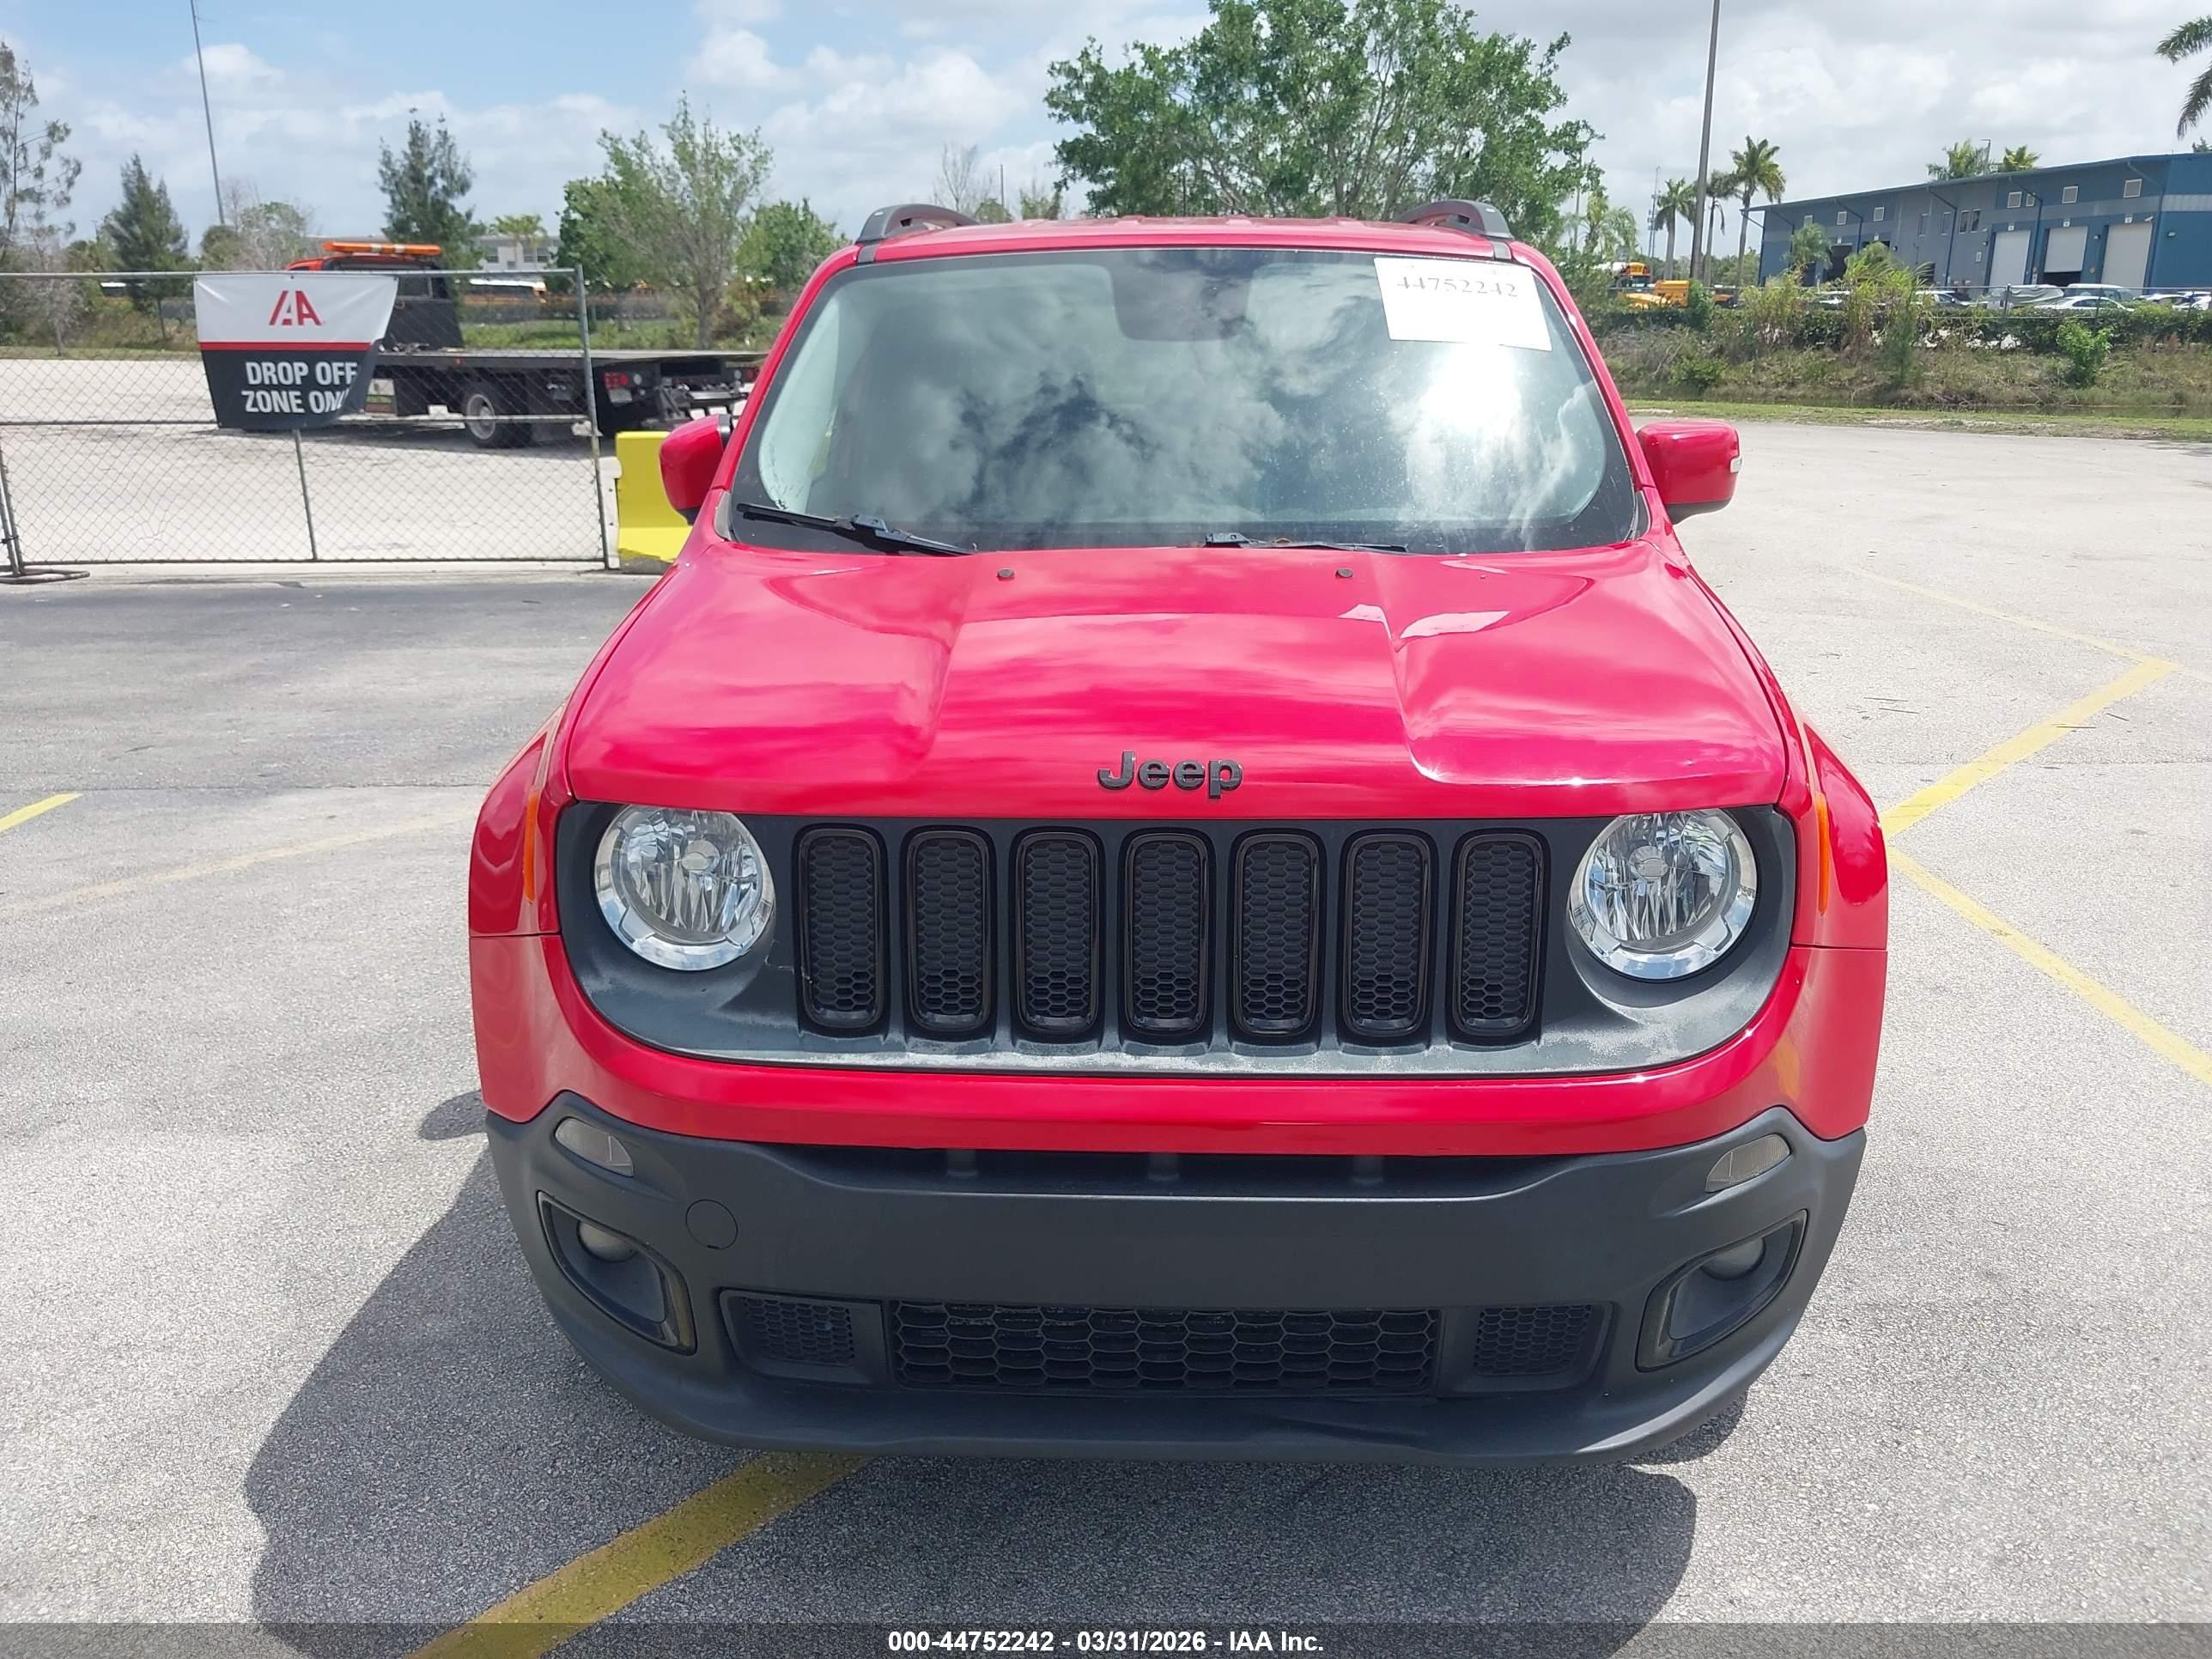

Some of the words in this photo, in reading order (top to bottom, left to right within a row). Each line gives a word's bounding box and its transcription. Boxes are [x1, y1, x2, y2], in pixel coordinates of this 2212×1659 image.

[1397, 276, 1519, 298] 44752242
[246, 362, 309, 386] DROP
[315, 361, 358, 386] OFF
[241, 390, 306, 414] ZONE
[308, 388, 349, 414] ONL
[1097, 750, 1244, 799] Jeep
